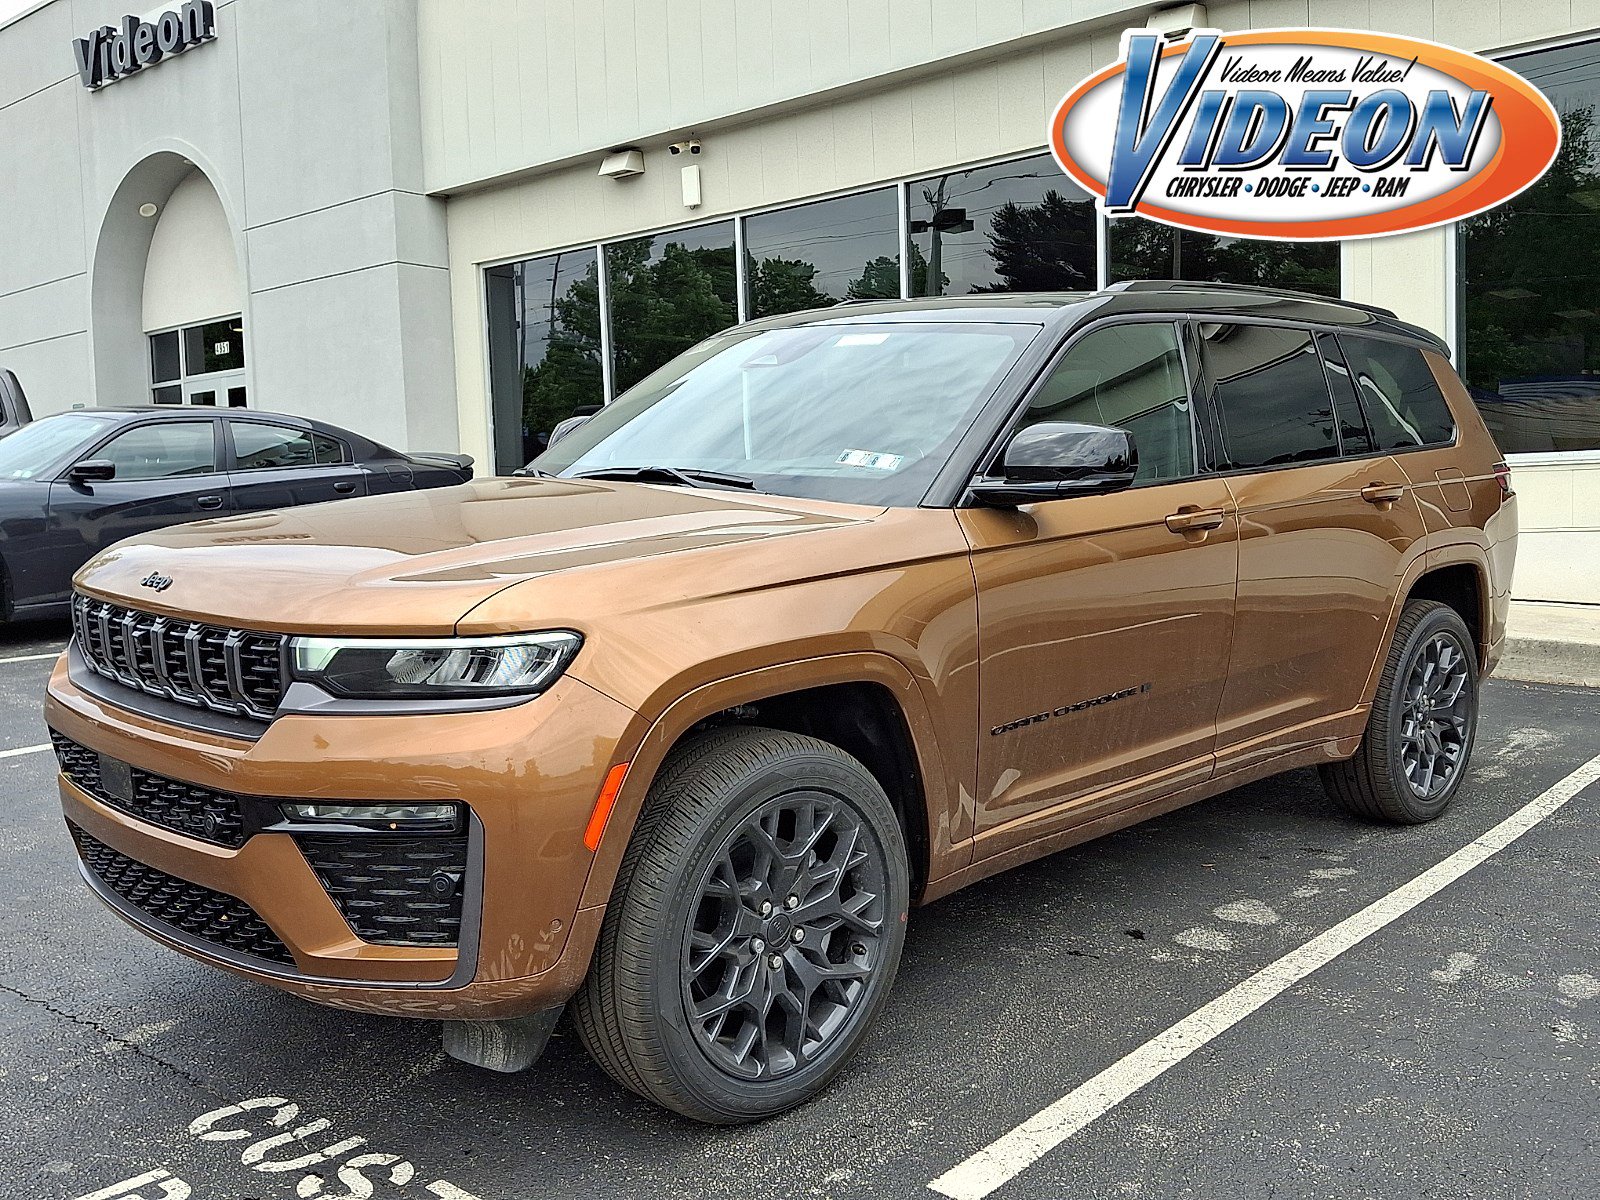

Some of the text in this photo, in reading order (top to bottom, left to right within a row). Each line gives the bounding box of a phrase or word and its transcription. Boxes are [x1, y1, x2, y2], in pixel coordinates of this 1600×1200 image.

[72, 1, 214, 88] Videon
[140, 570, 174, 593] Jeep
[988, 710, 1050, 736] GRAND
[1053, 685, 1138, 717] CHEROKEE
